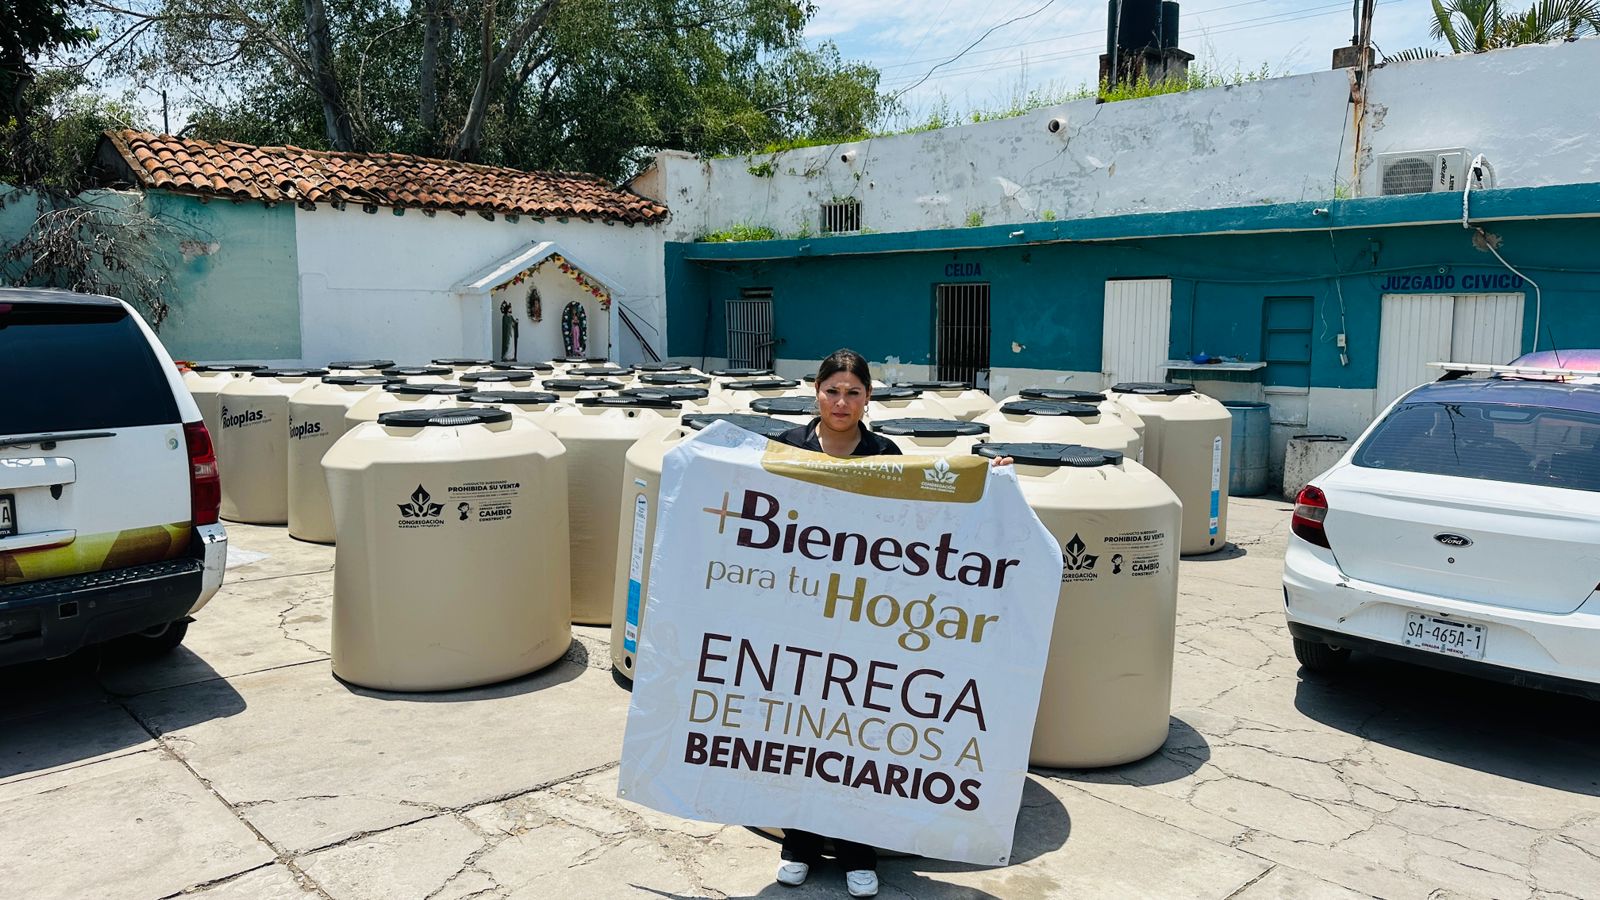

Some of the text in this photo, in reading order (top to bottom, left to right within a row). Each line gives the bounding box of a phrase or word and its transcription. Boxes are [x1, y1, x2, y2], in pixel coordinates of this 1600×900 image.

[944, 263, 983, 277] CELDA
[1381, 273, 1524, 291] JUZGADO CIVICO
[448, 485, 488, 493] PROHIBIDA
[479, 508, 512, 518] CAMBIO
[1103, 535, 1142, 543] PROHIBIDA
[1143, 534, 1151, 542] SU
[1131, 562, 1160, 572] CAMBIO
[705, 559, 1000, 652] para tu Hogar
[1407, 621, 1481, 650] SA-465A-1
[697, 632, 987, 732] ENTREGA
[688, 689, 985, 772] DE TINACOS A
[684, 732, 982, 812] BENEFICIARIOS
